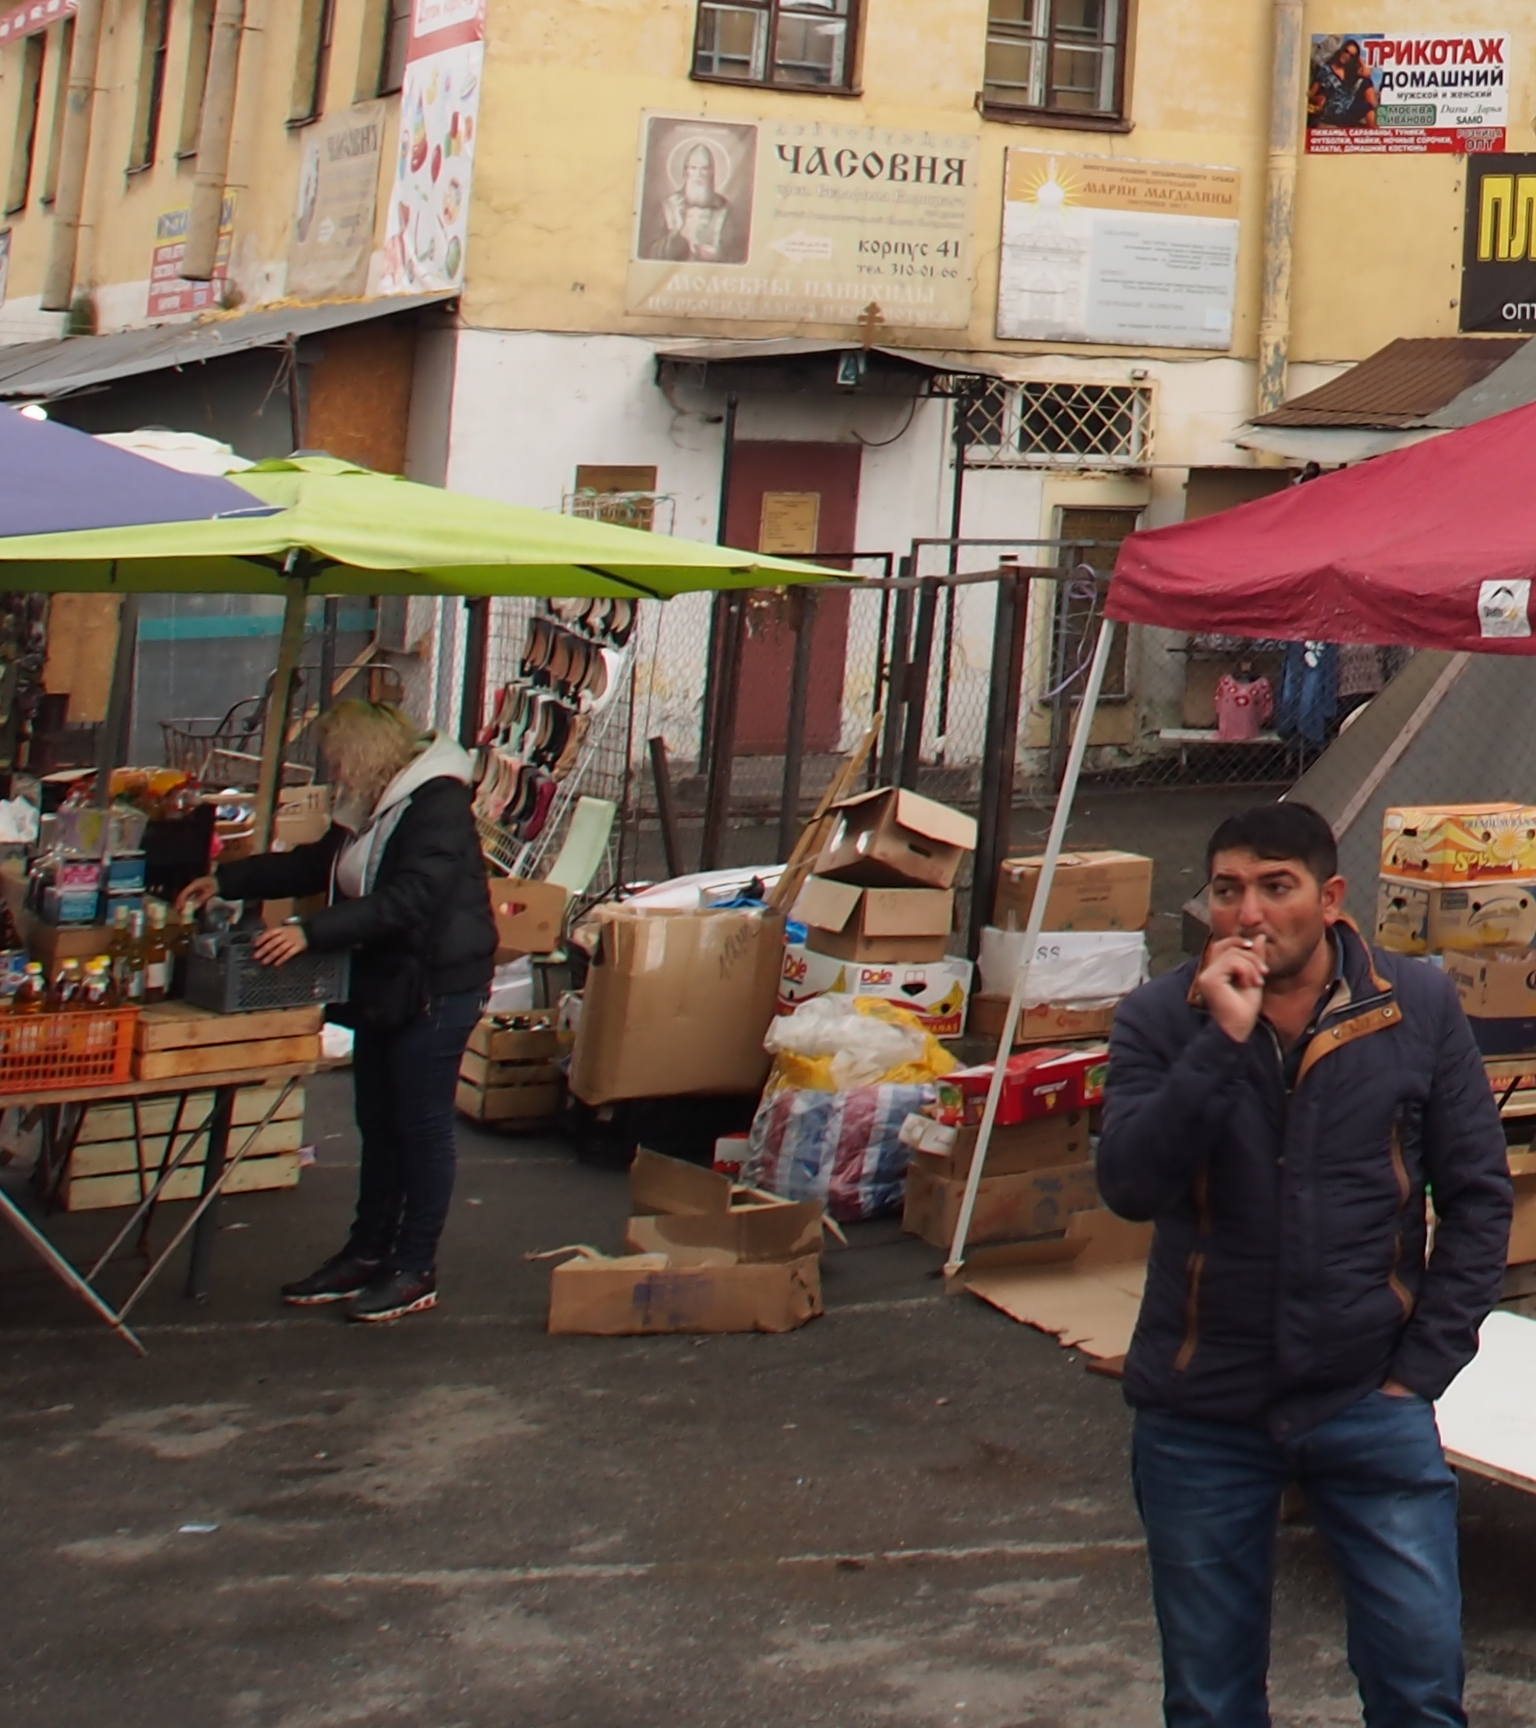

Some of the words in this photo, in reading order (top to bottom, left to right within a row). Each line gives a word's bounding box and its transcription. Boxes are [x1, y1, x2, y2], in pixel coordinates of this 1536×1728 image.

[1364, 38, 1504, 67] ТРИКОТАЖ
[1379, 65, 1504, 92] ДОМАШНИЙ
[1396, 90, 1439, 101] мужской
[1449, 89, 1492, 99] женский
[1387, 115, 1433, 124] ИВАНОВО
[1388, 106, 1432, 114] МОСКВА
[1465, 139, 1494, 151] ОПТ
[776, 144, 967, 187] ЧАСОВНЯ
[1144, 186, 1232, 205] МАГДАЛИНЫ
[858, 238, 929, 263] корпус
[935, 240, 961, 259] 41
[784, 954, 808, 981] Dole
[861, 968, 893, 985] Dole
